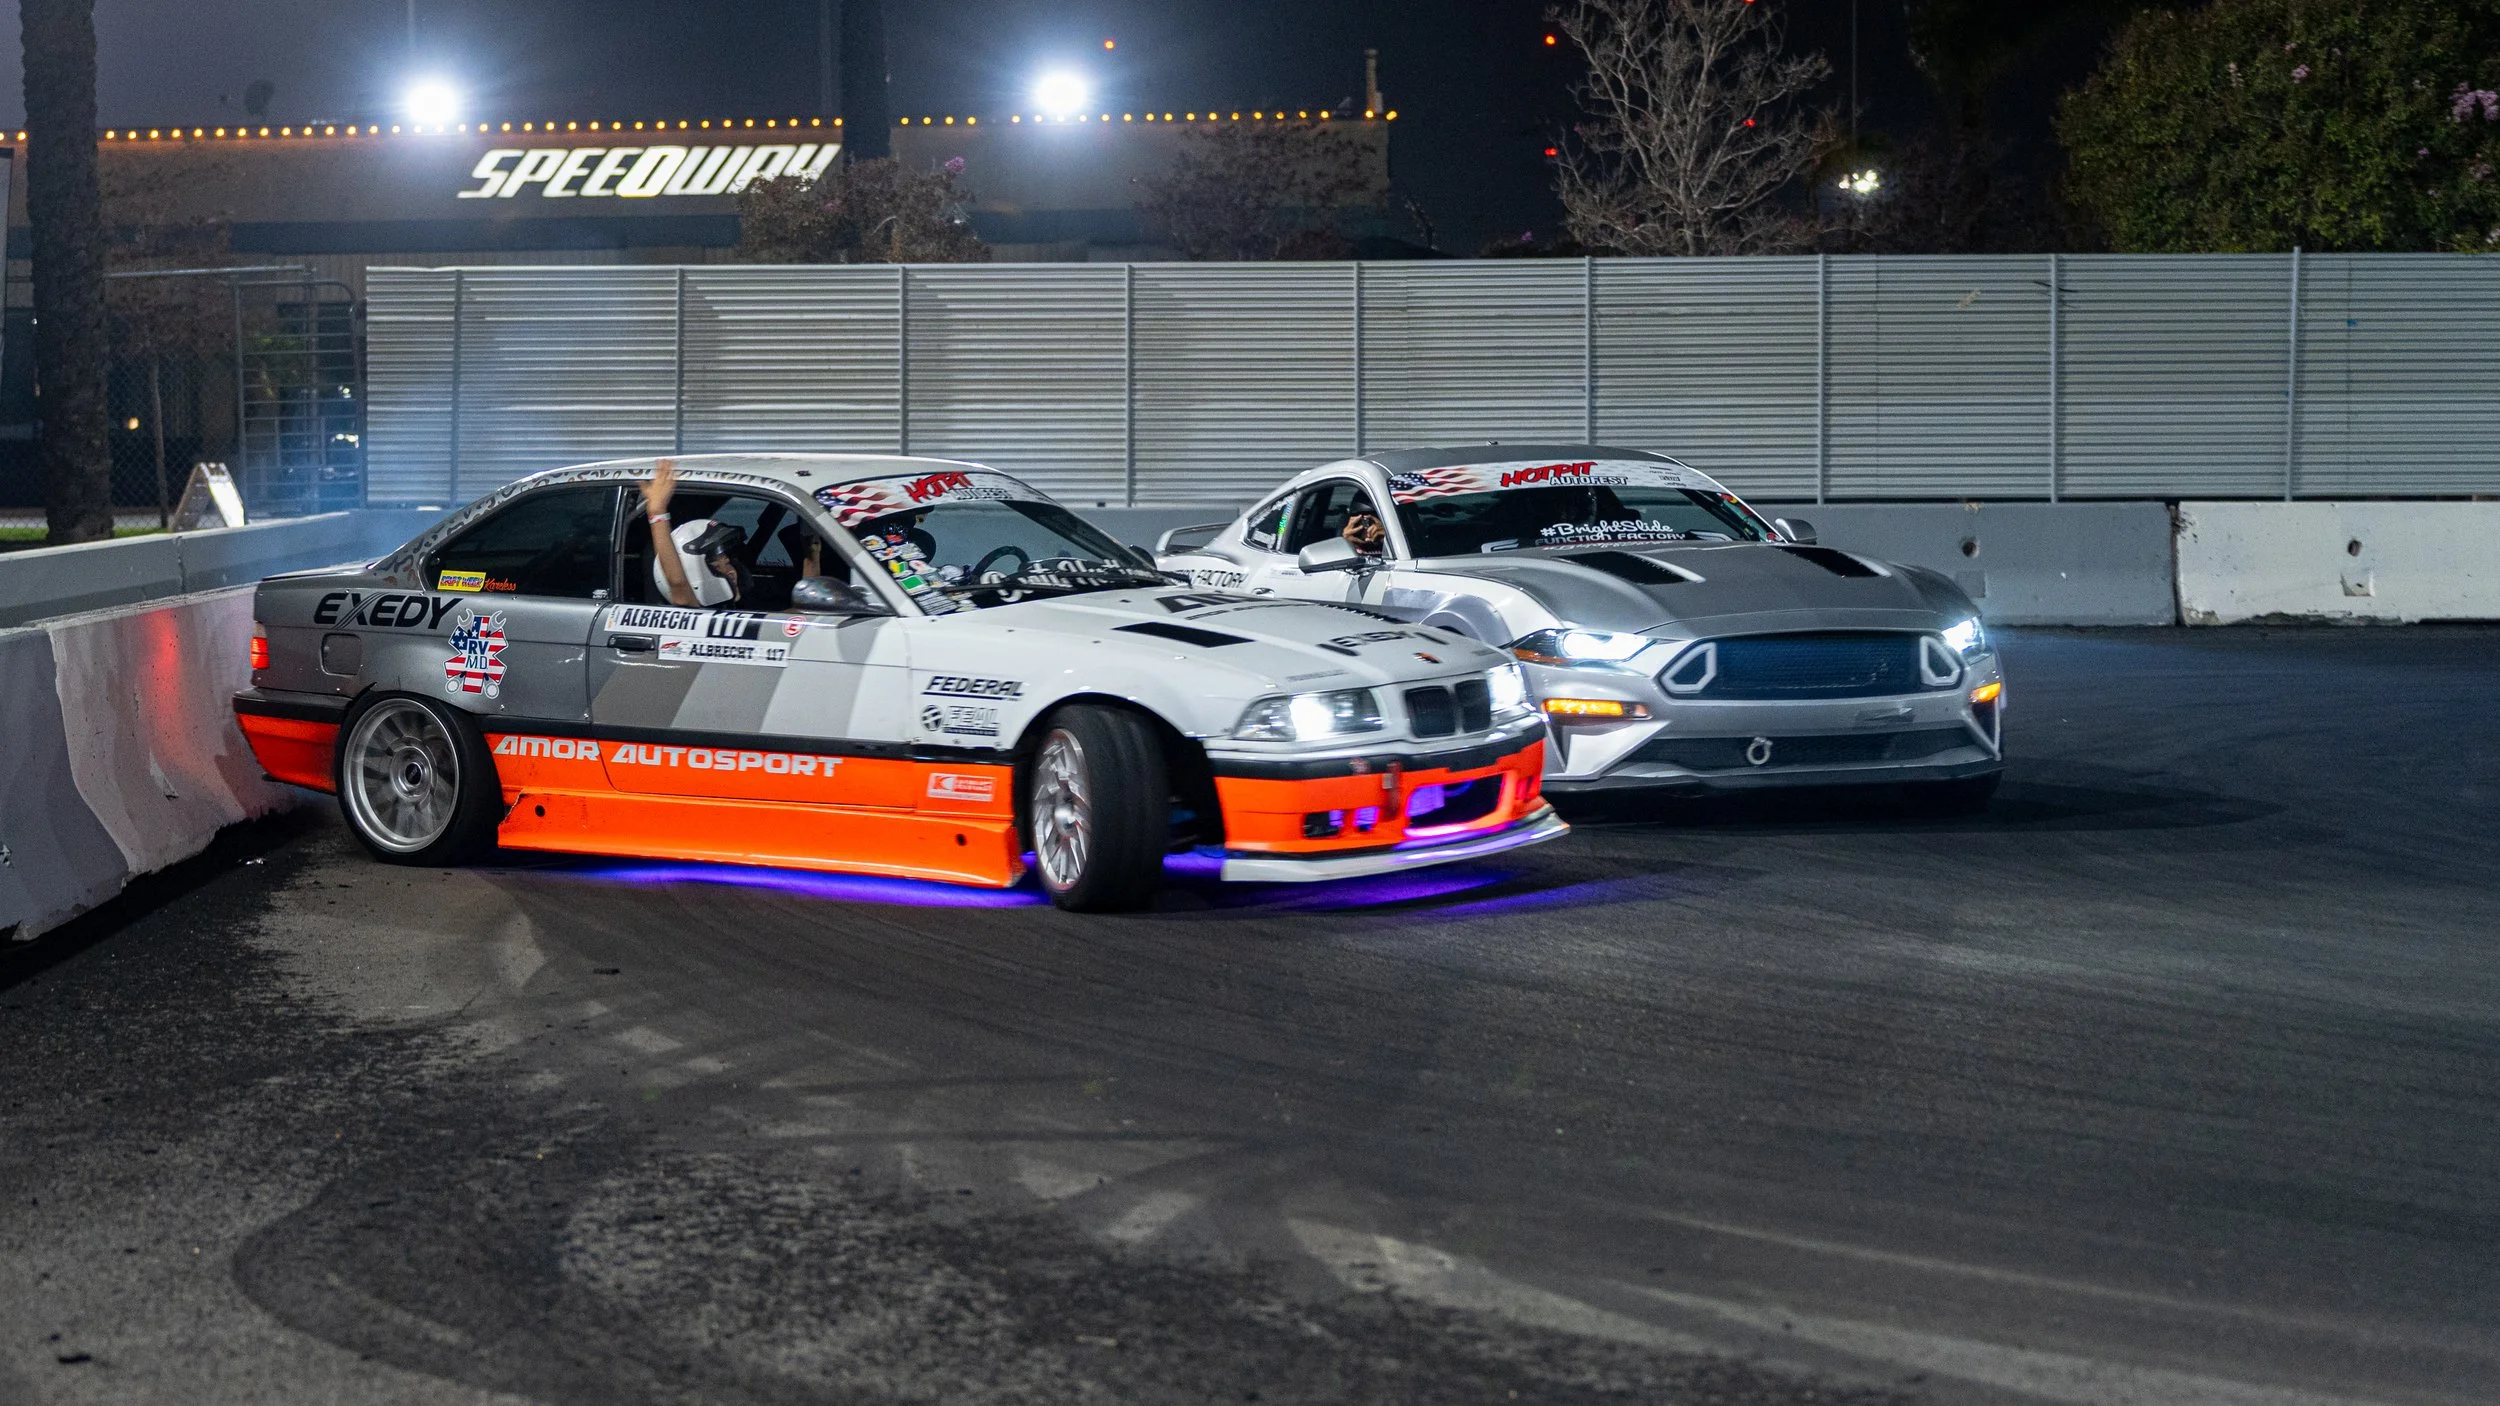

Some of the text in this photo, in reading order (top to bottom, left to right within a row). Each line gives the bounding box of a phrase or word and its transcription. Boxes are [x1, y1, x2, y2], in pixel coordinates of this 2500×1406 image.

[457, 144, 842, 198] SPEEDWAY
[1500, 462, 1598, 488] HOTPIT
[1550, 475, 1628, 486] AUTOFEST
[1540, 520, 1673, 538] #BrightSlide
[1618, 532, 1686, 541] FACTORY
[1197, 569, 1250, 589] FACTORY
[313, 591, 464, 630] EXEDY
[620, 608, 703, 630] ALBRECHT
[712, 612, 754, 637] 117
[467, 640, 489, 655] RV
[688, 644, 785, 661] ALBRECHT 117
[465, 655, 488, 669] MD
[925, 675, 1026, 698] FEDERAL
[494, 736, 843, 777] AMOR AUTOSPORT
